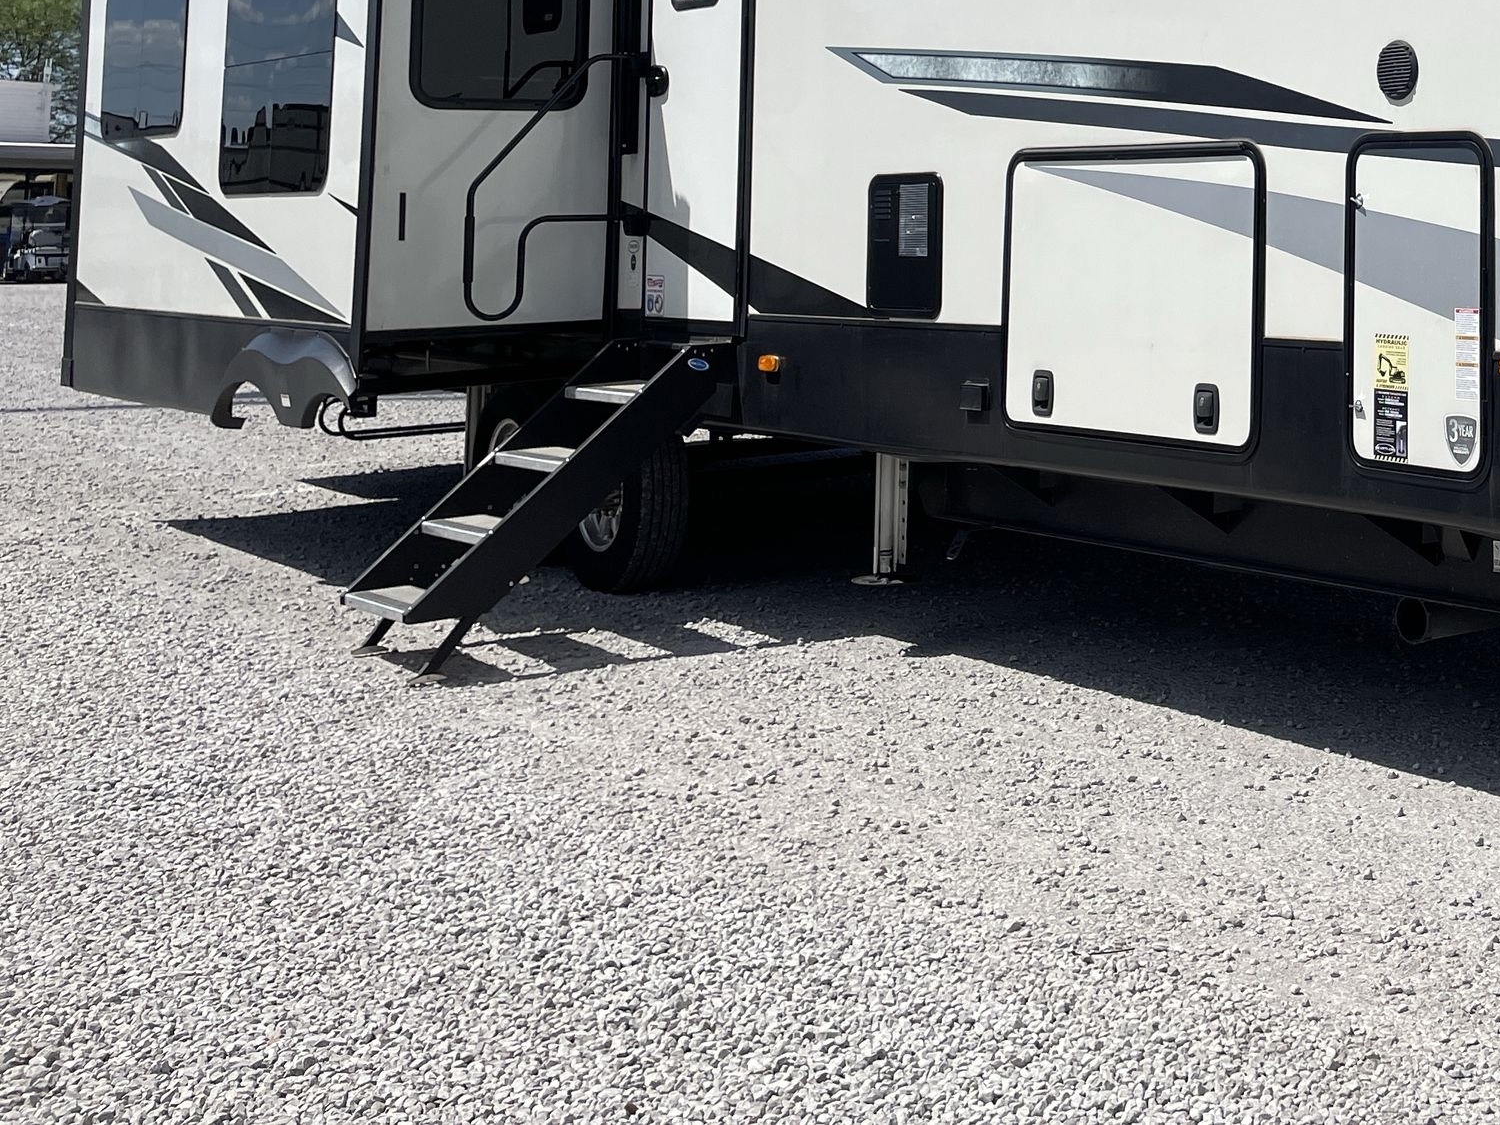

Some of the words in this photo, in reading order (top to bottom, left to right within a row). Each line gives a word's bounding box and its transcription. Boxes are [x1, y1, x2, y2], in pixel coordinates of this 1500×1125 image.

[1375, 338, 1408, 346] HYDRAULIC
[1448, 418, 1458, 443] 3
[1458, 424, 1474, 438] YEAR
